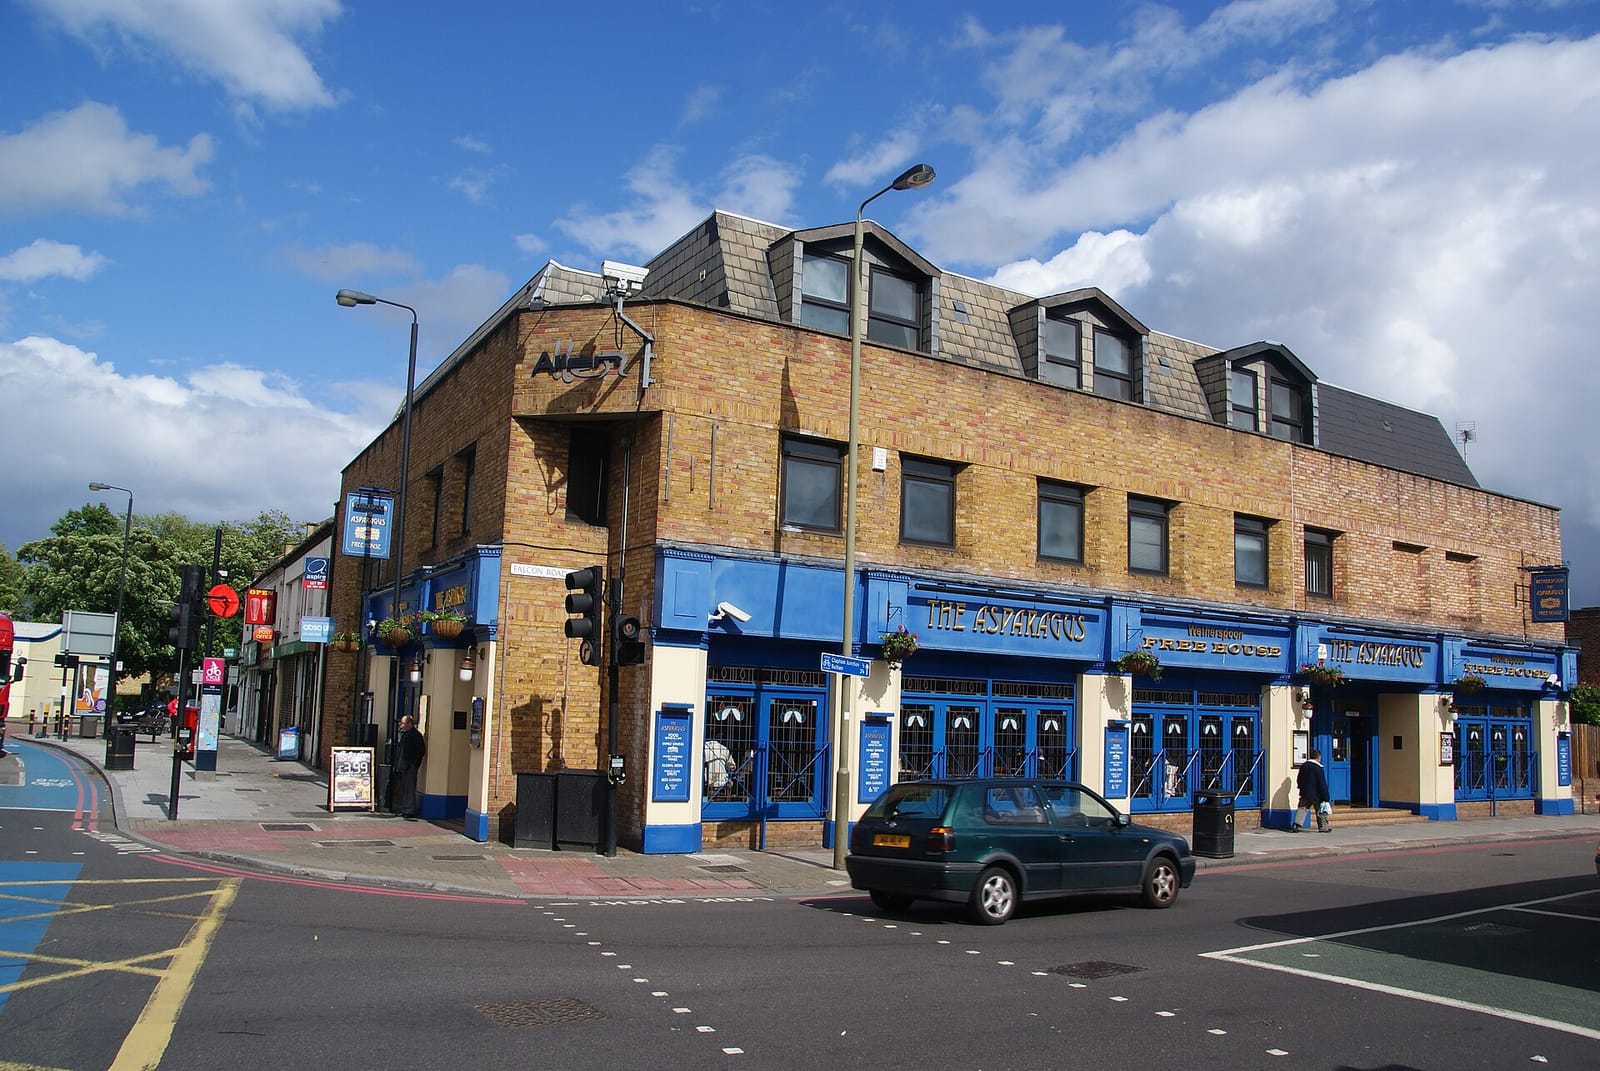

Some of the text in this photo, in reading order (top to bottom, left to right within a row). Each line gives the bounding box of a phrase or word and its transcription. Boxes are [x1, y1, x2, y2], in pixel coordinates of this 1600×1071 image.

[306, 573, 326, 581] aspire
[513, 565, 567, 578] FALCON ROAD
[927, 600, 1086, 641] THE ASPARAGUS
[1187, 624, 1243, 640] Wetherspoon
[1143, 637, 1282, 658] FREE HOUSE
[1331, 640, 1424, 668] THE ASPARAGUS
[1463, 664, 1549, 679] FREE HOUSE
[338, 761, 368, 774] £3.99
